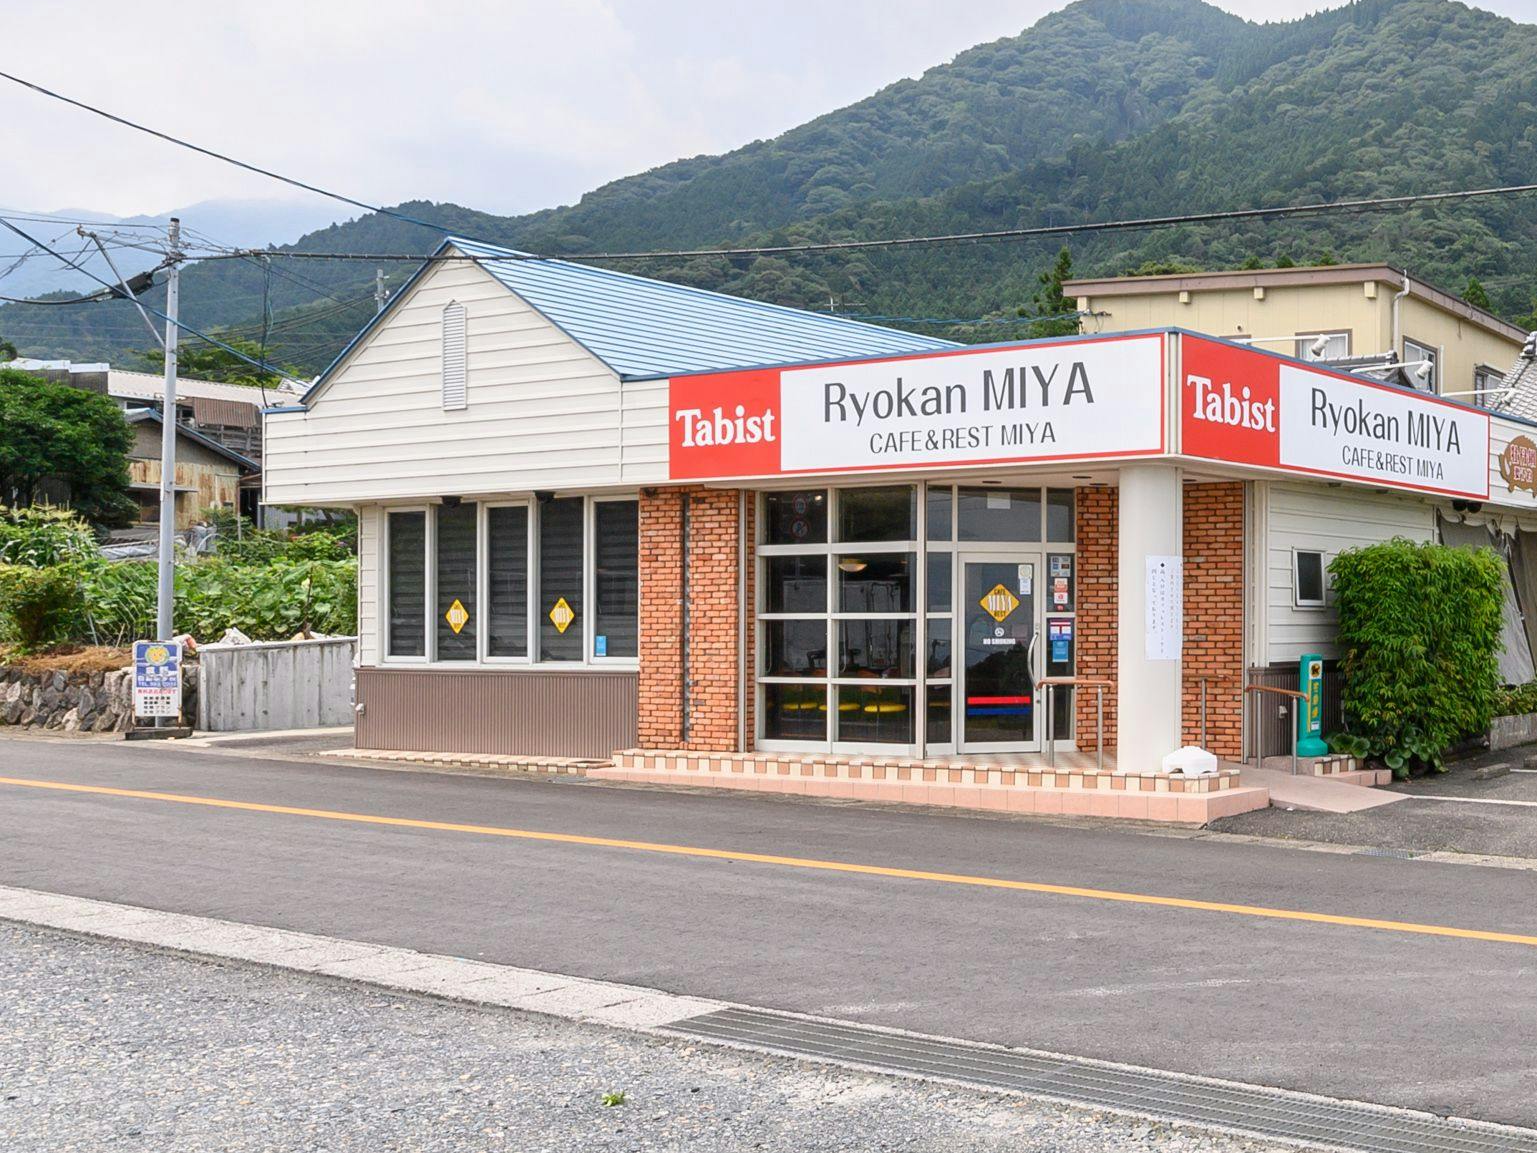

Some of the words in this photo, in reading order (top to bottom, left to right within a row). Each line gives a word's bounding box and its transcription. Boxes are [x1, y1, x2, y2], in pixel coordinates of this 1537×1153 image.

[824, 377, 967, 427] Ryokan
[982, 361, 1094, 412] MIYA
[1186, 374, 1276, 433] Tabist
[675, 404, 776, 448] Tabist
[870, 425, 994, 454] CAFE&REST
[1001, 421, 1056, 446] MIYA
[1311, 387, 1399, 443] Ryokan
[1407, 410, 1461, 455] MIYA
[1342, 445, 1414, 475] CAFE&REST
[1416, 458, 1444, 480] MIYA
[988, 595, 1012, 611] MIYA
